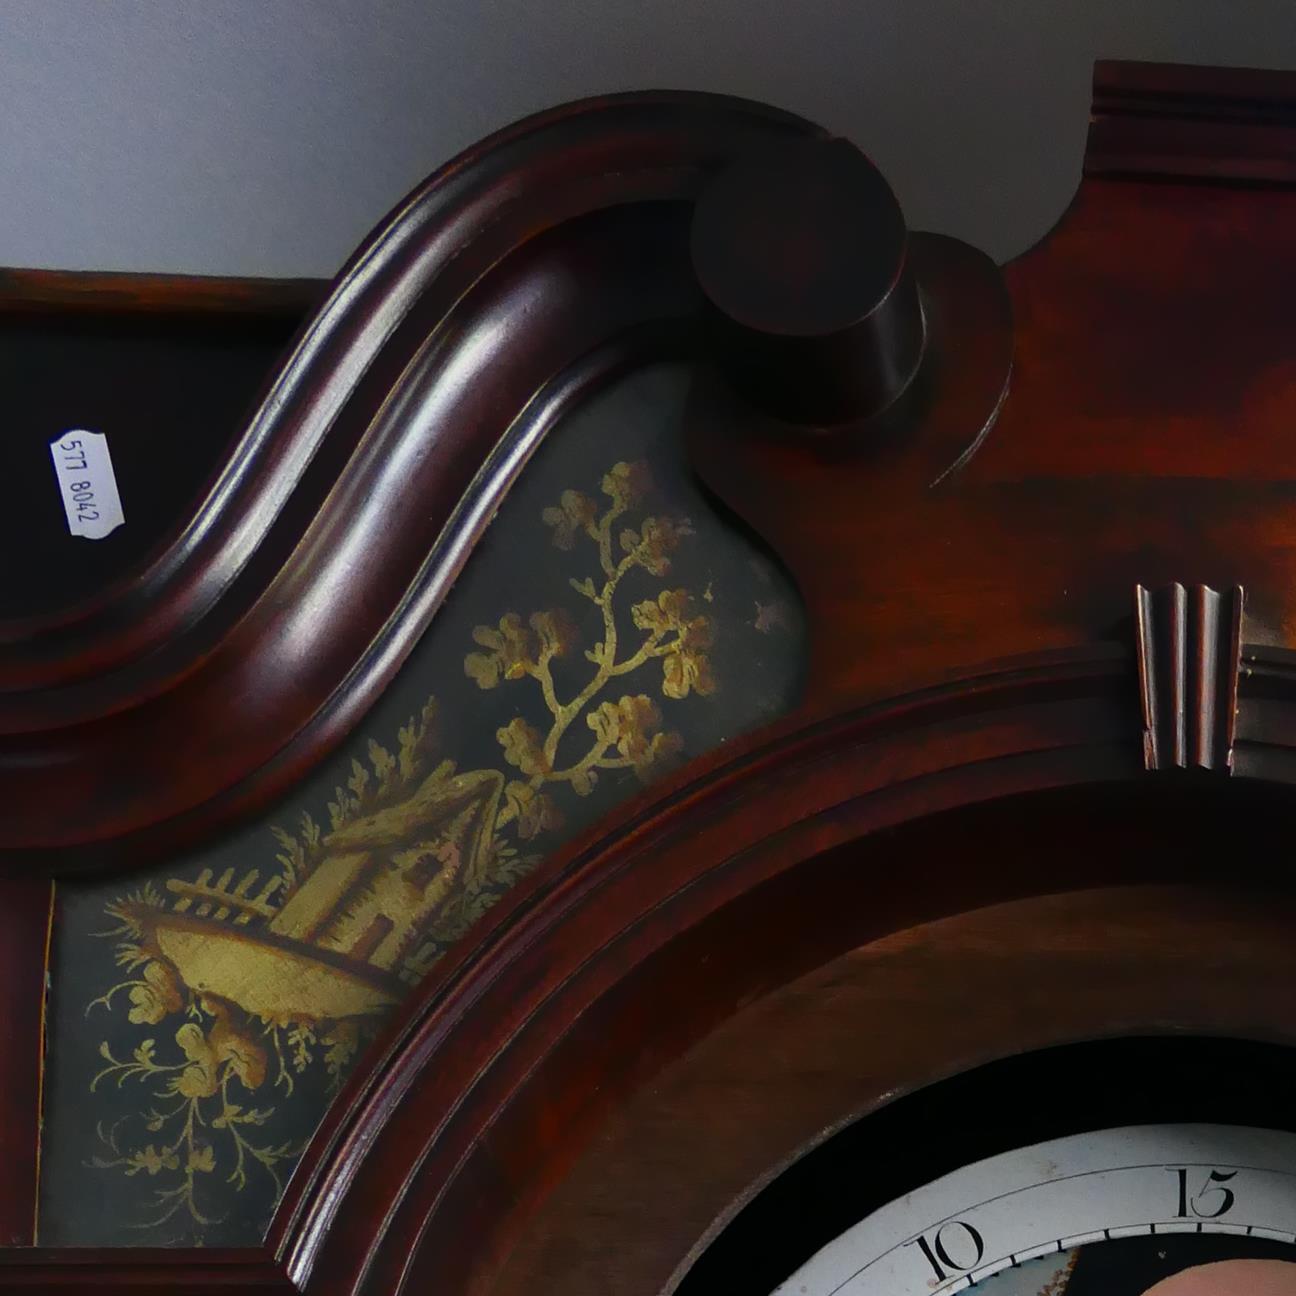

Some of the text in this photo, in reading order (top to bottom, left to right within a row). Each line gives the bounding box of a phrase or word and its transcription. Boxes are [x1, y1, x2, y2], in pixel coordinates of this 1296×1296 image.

[61, 440, 100, 522] 577 8042
[1165, 1167, 1239, 1220] 15
[903, 1220, 985, 1285] 10
